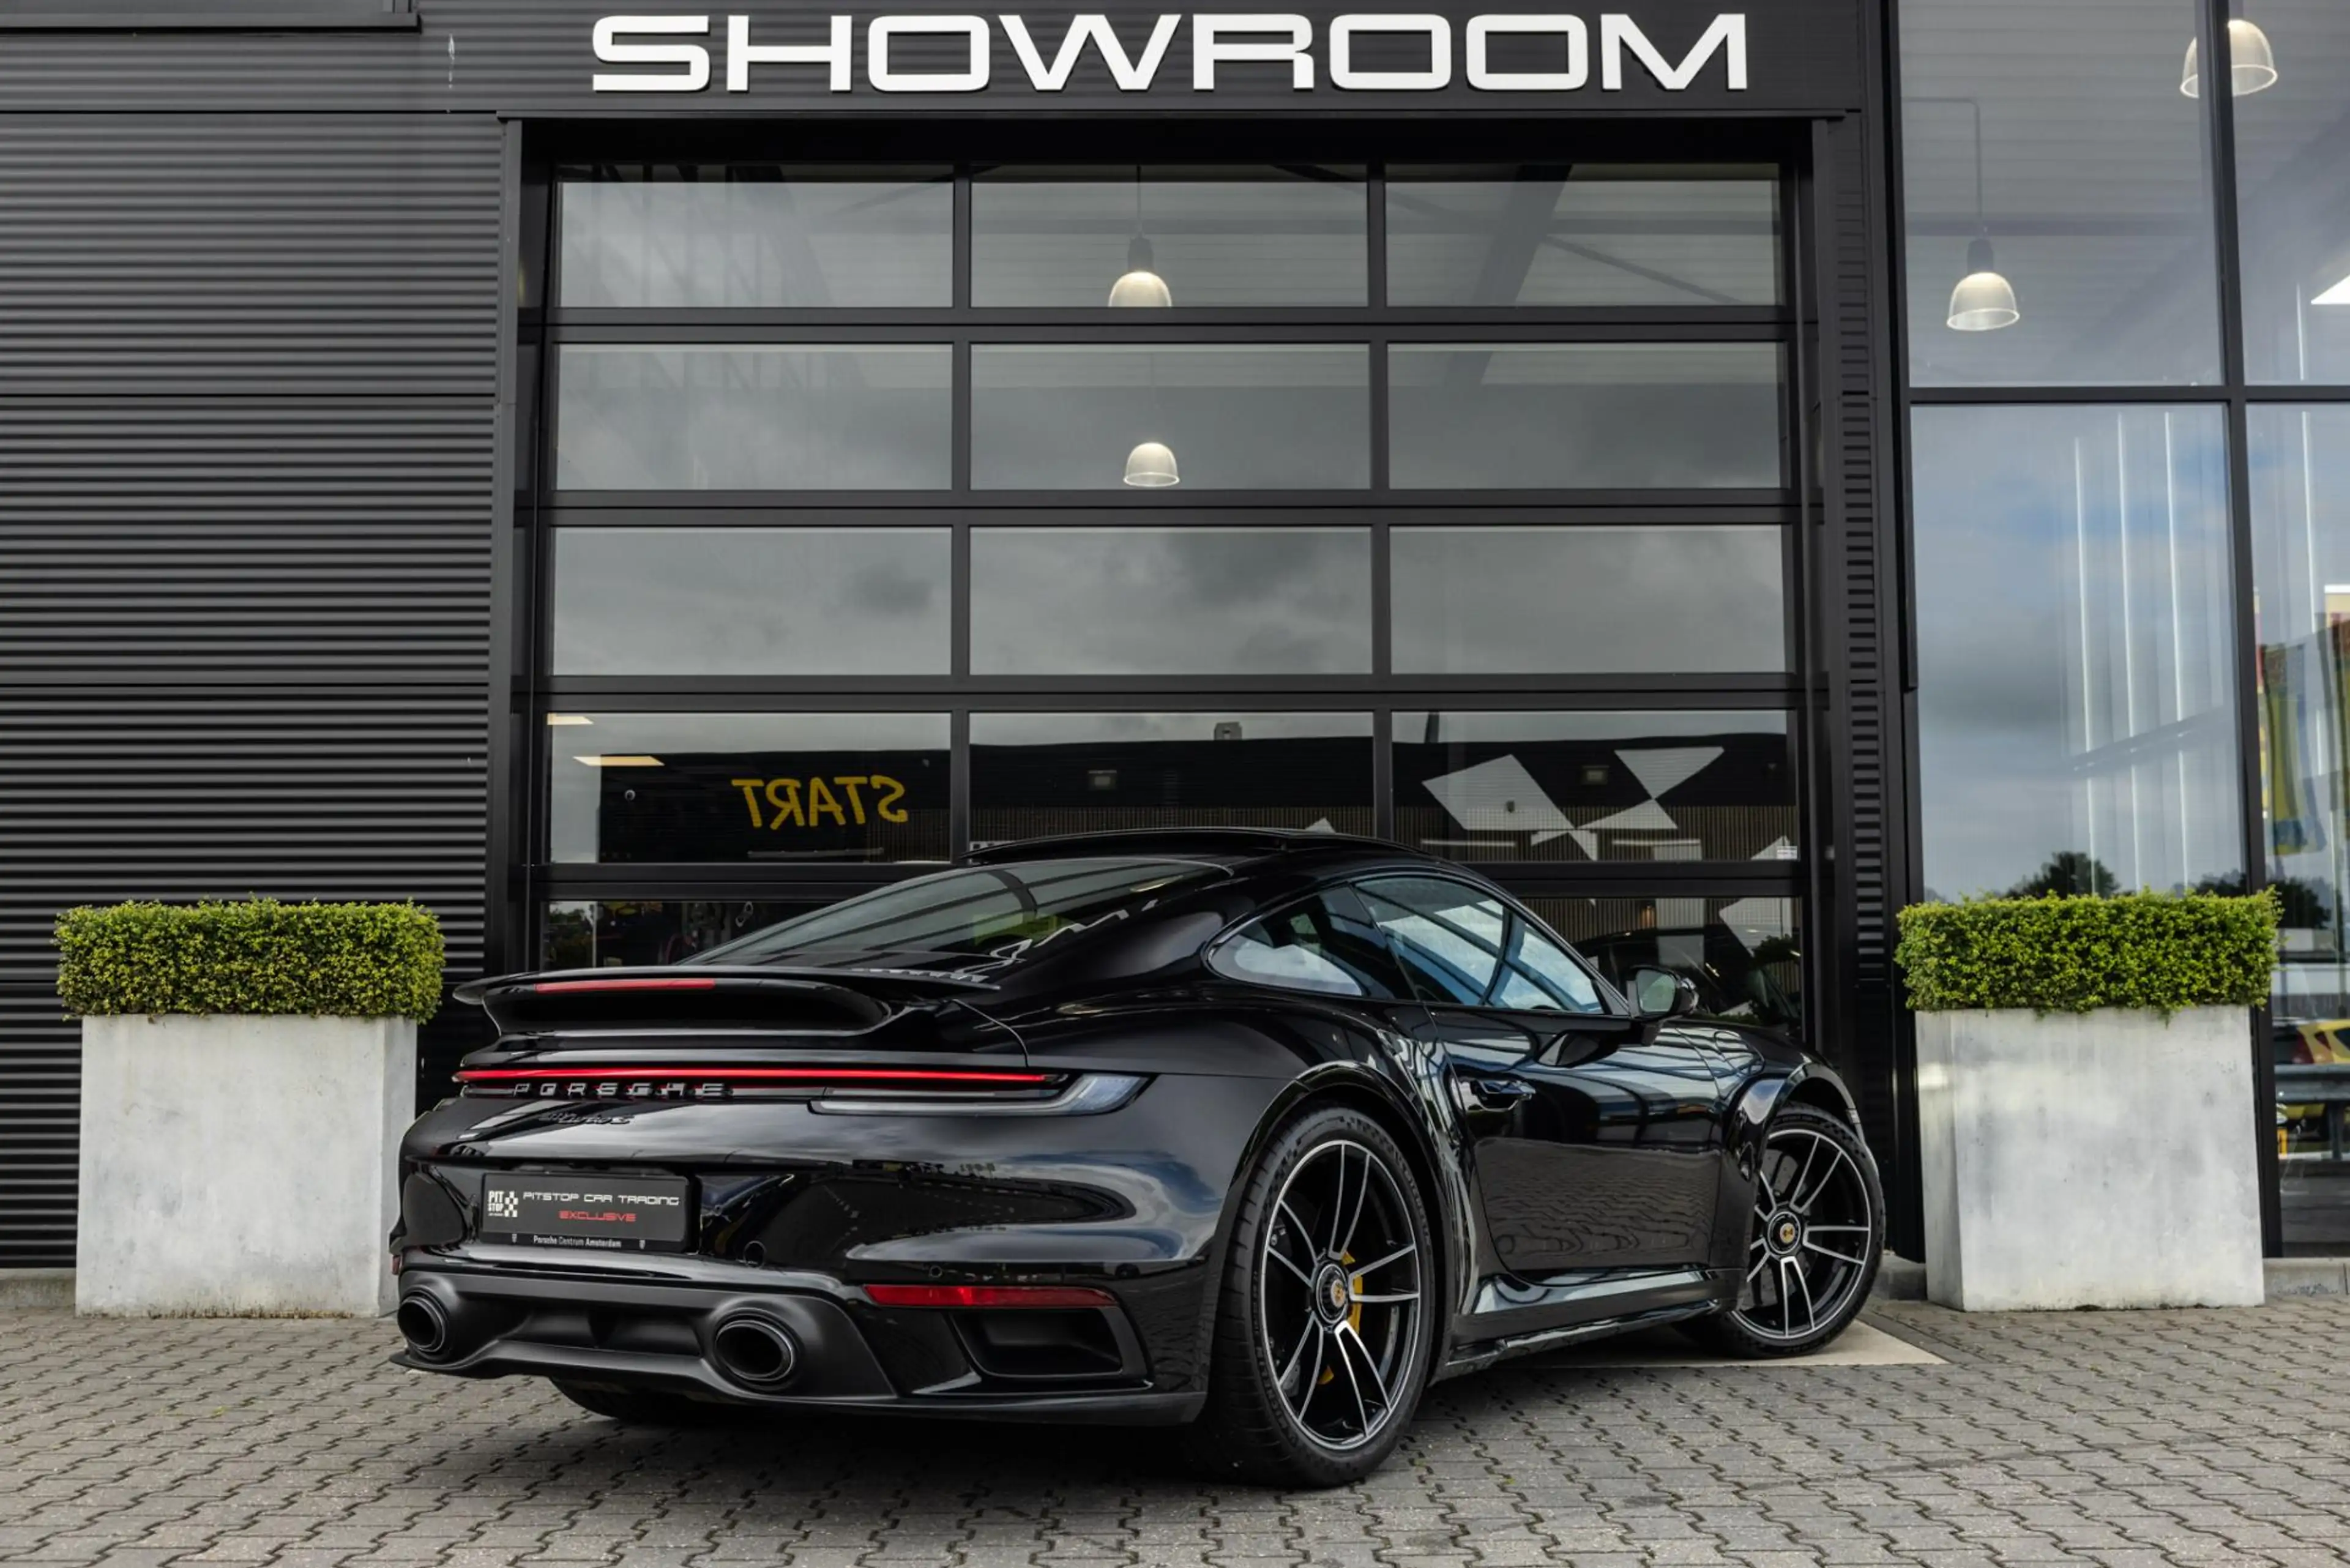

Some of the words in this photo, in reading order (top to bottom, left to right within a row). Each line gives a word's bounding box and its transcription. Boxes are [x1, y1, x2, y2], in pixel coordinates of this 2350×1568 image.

[592, 13, 1748, 94] SHOWROOM
[513, 1082, 728, 1097] PORSCHE
[488, 1190, 504, 1203] PIT
[523, 1192, 580, 1202] PITSTOP
[583, 1193, 613, 1203] CAR
[617, 1195, 679, 1206] TRADING
[488, 1203, 504, 1212] STOP
[558, 1210, 637, 1222] EXCLUSIVE
[534, 1235, 558, 1245] Porsche
[559, 1236, 584, 1246] Centrum
[585, 1238, 622, 1248] Amsterdam
